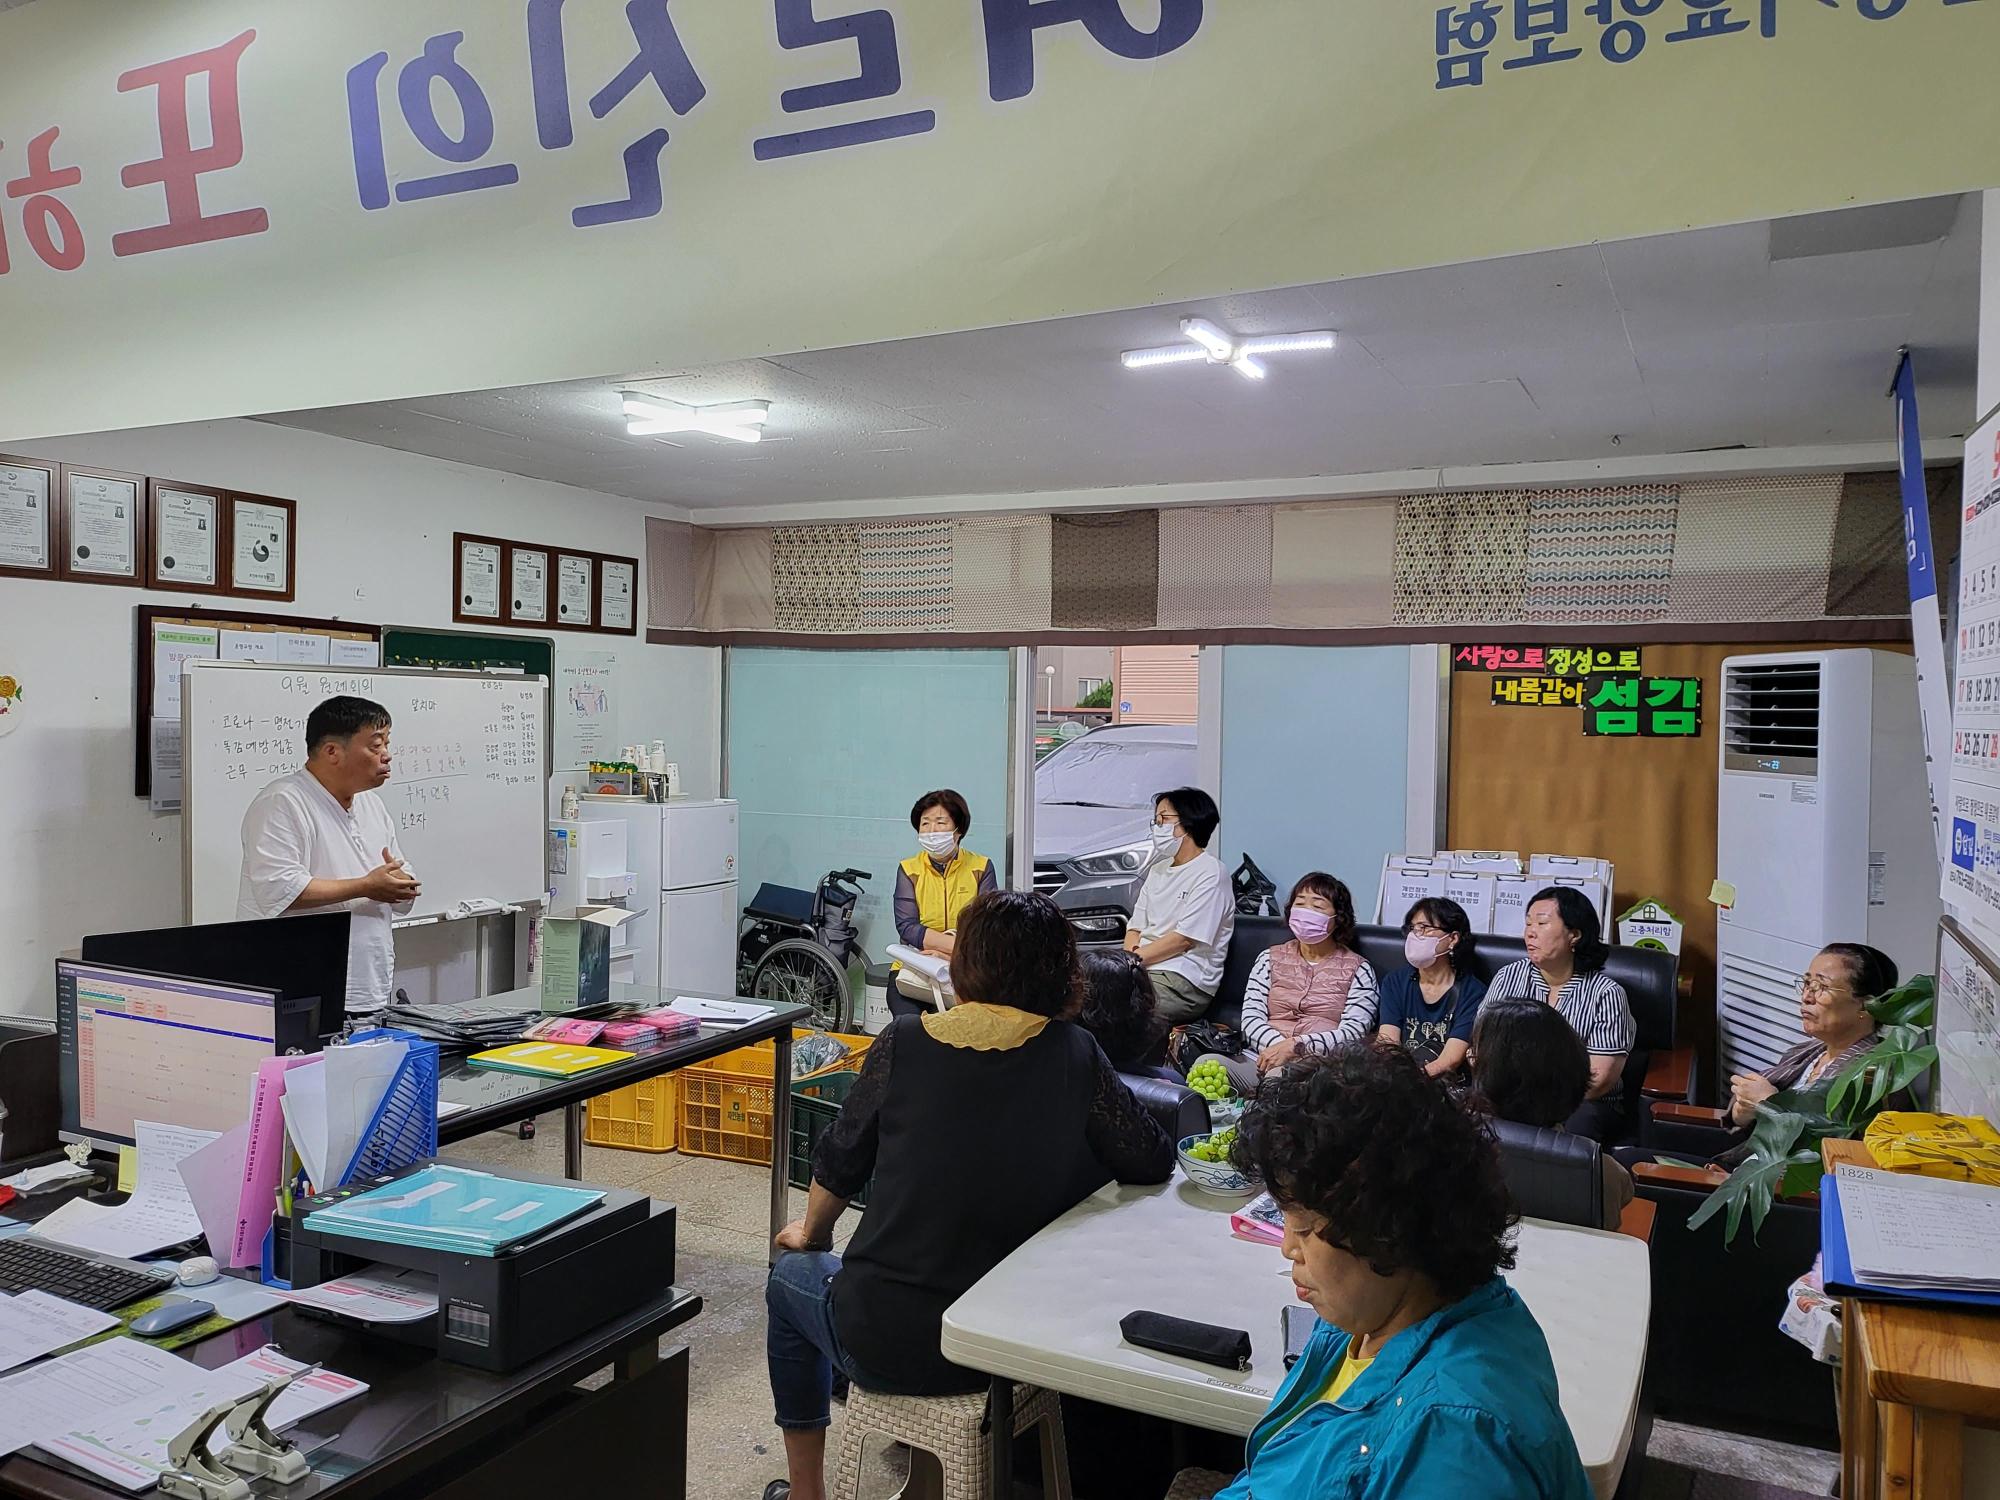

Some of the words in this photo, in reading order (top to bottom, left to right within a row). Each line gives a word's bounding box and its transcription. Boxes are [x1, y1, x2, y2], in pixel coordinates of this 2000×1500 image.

[1456, 646, 1545, 670] 사랑으로
[1547, 647, 1641, 675] 정성으로
[1495, 677, 1582, 705] 내몸같이
[1589, 679, 1698, 733] 섬김
[223, 714, 254, 731] 코로나
[1839, 1166, 1875, 1181] 1828
